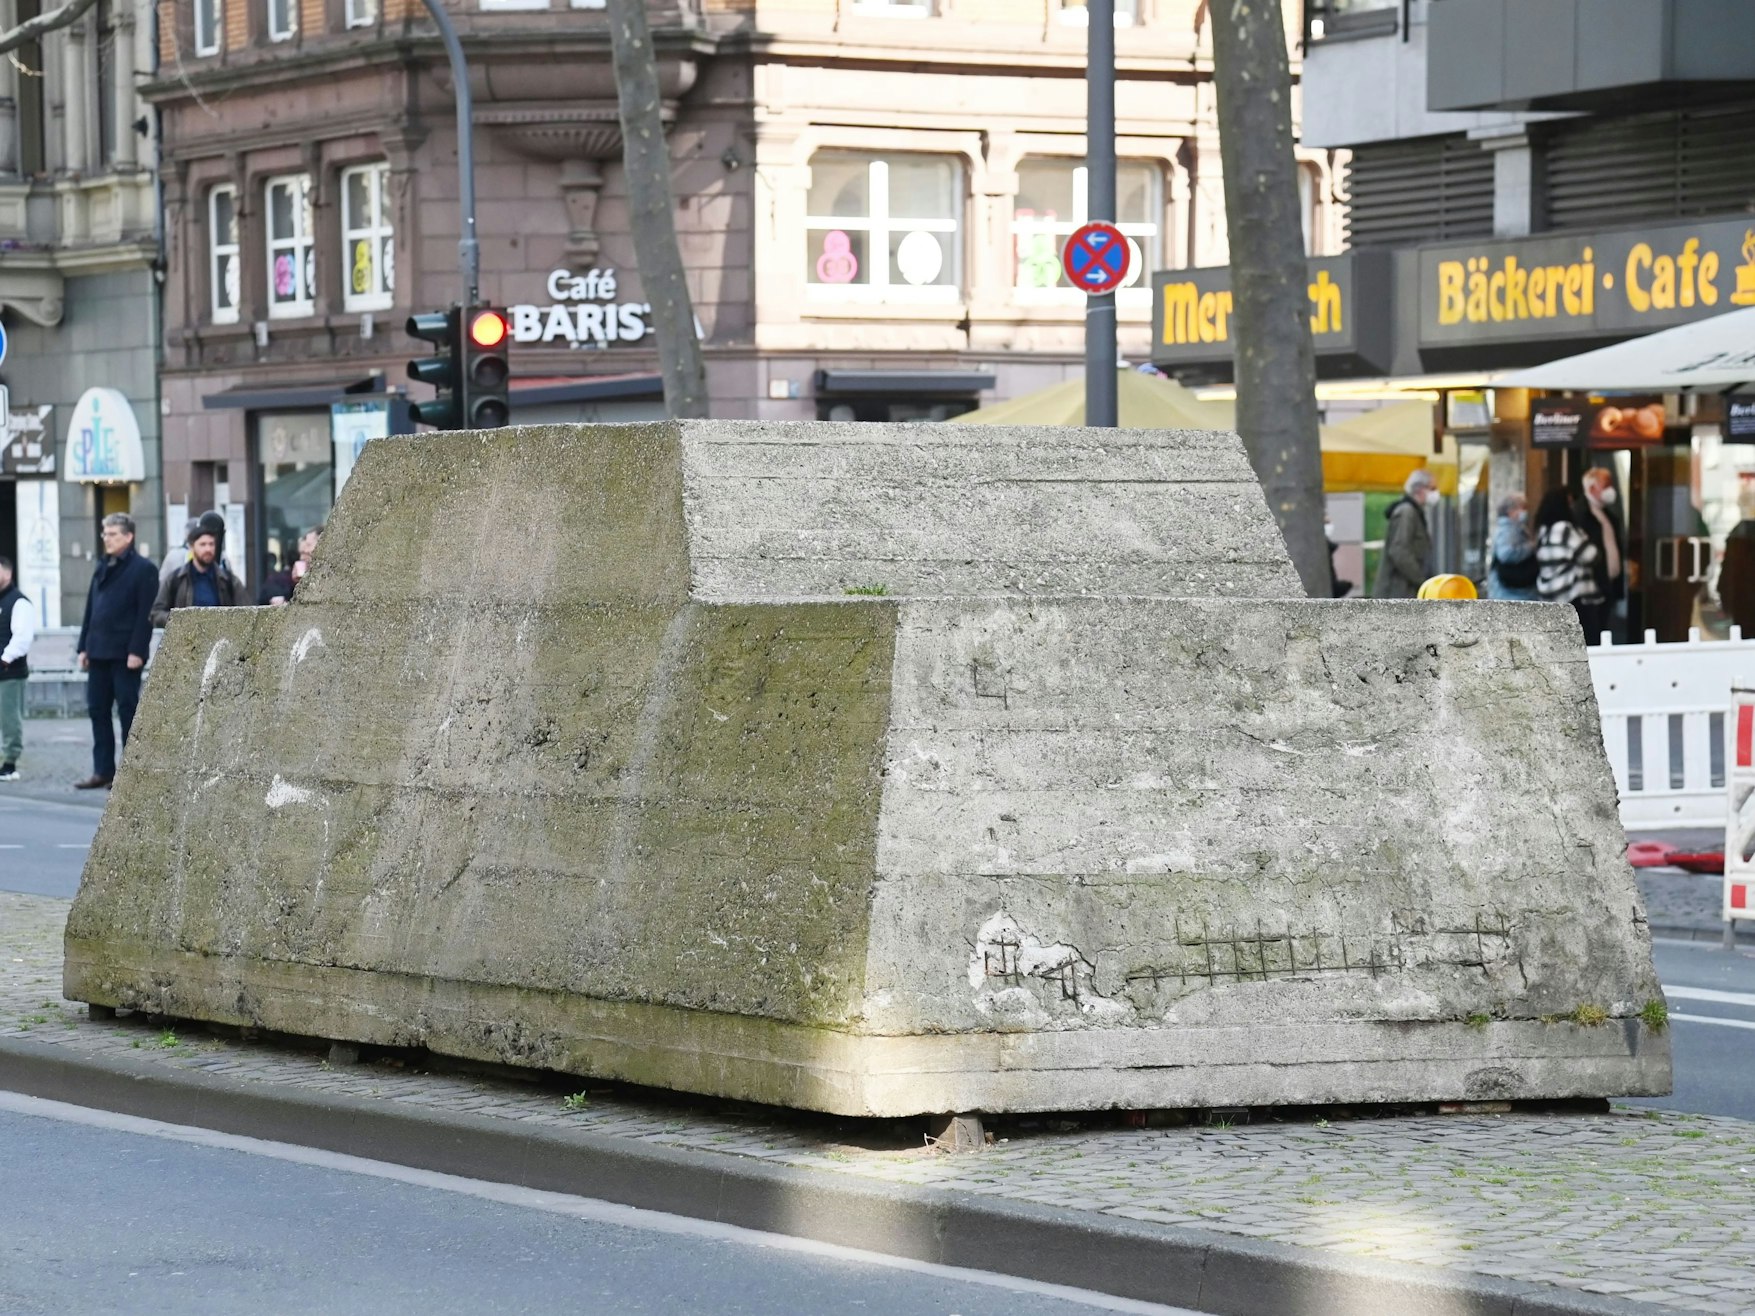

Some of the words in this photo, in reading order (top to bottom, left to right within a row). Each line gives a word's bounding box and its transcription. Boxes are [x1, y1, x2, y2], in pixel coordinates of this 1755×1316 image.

[547, 268, 616, 300] Café
[1438, 246, 1595, 325] Bäckerei
[1625, 237, 1720, 312] Cafe
